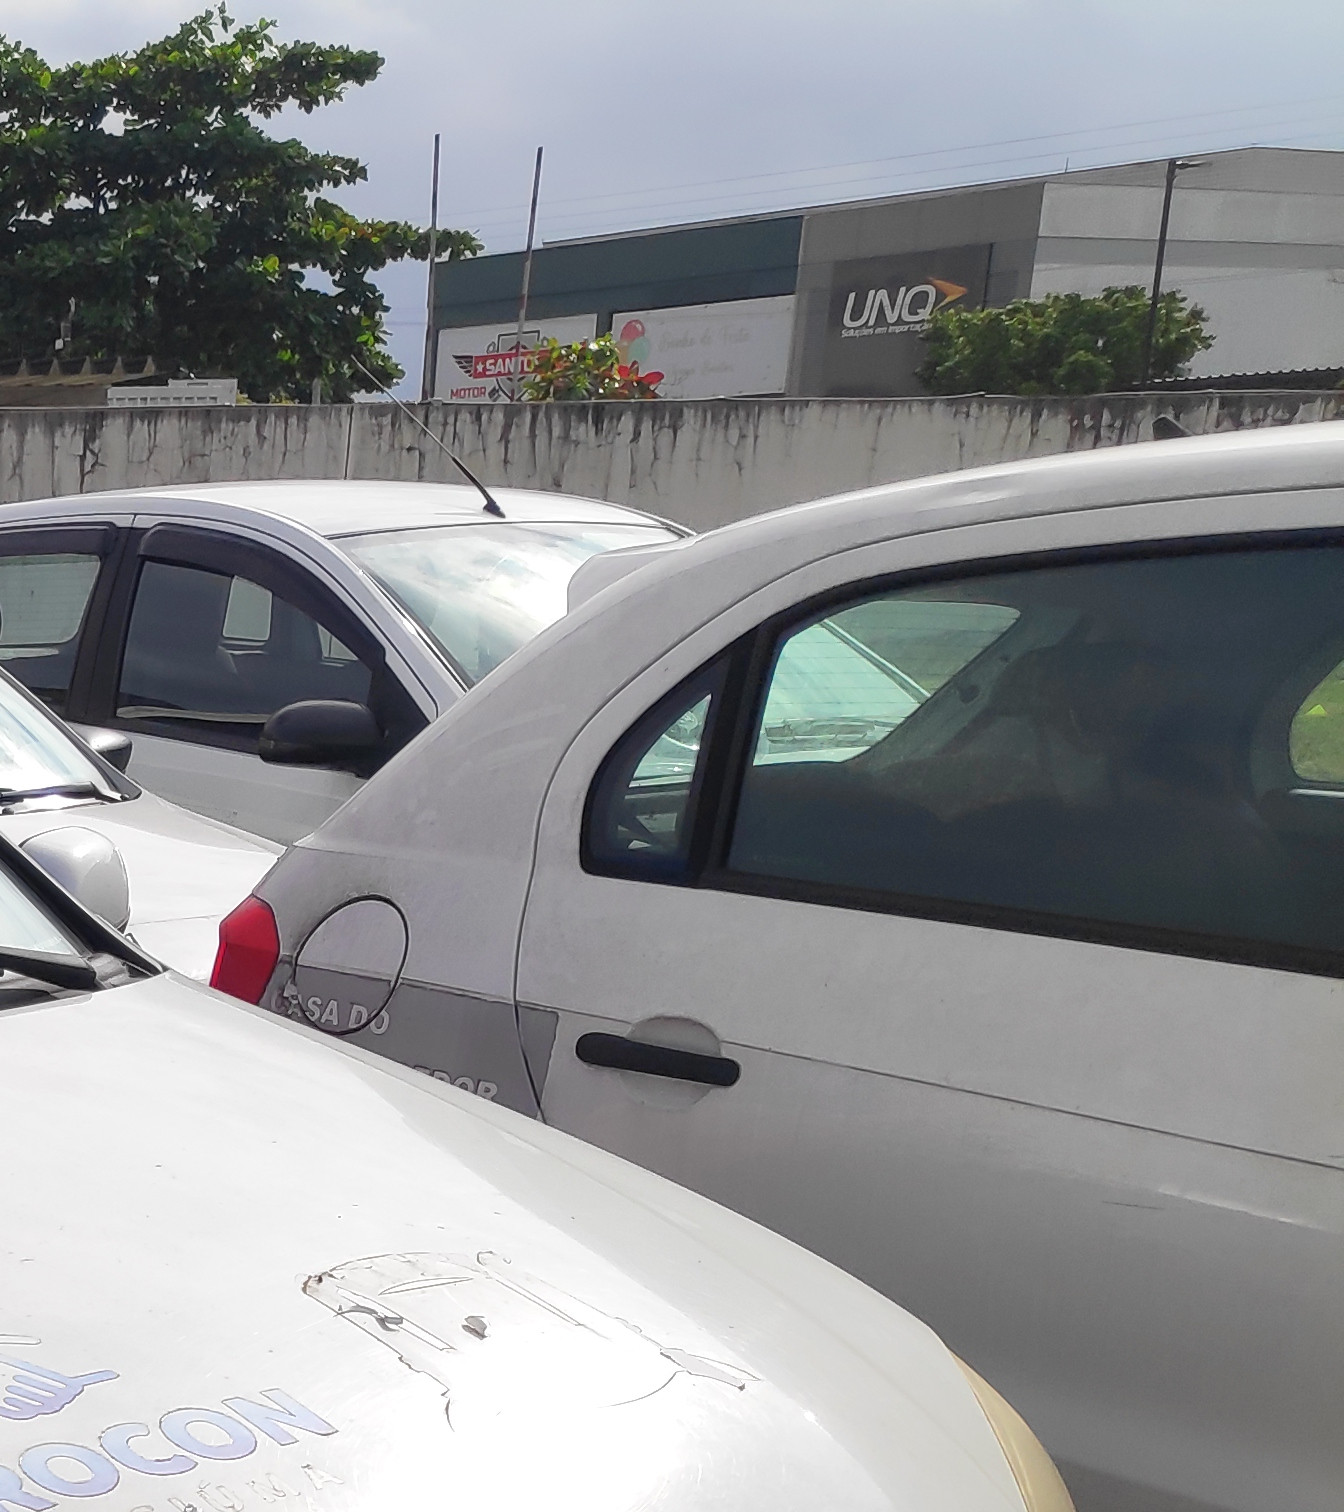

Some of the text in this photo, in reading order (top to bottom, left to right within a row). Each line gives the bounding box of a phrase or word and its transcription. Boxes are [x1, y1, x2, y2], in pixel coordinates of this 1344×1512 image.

[842, 284, 936, 328] UNQ
[450, 386, 487, 400] MOTOR
[348, 1003, 391, 1035] DO
